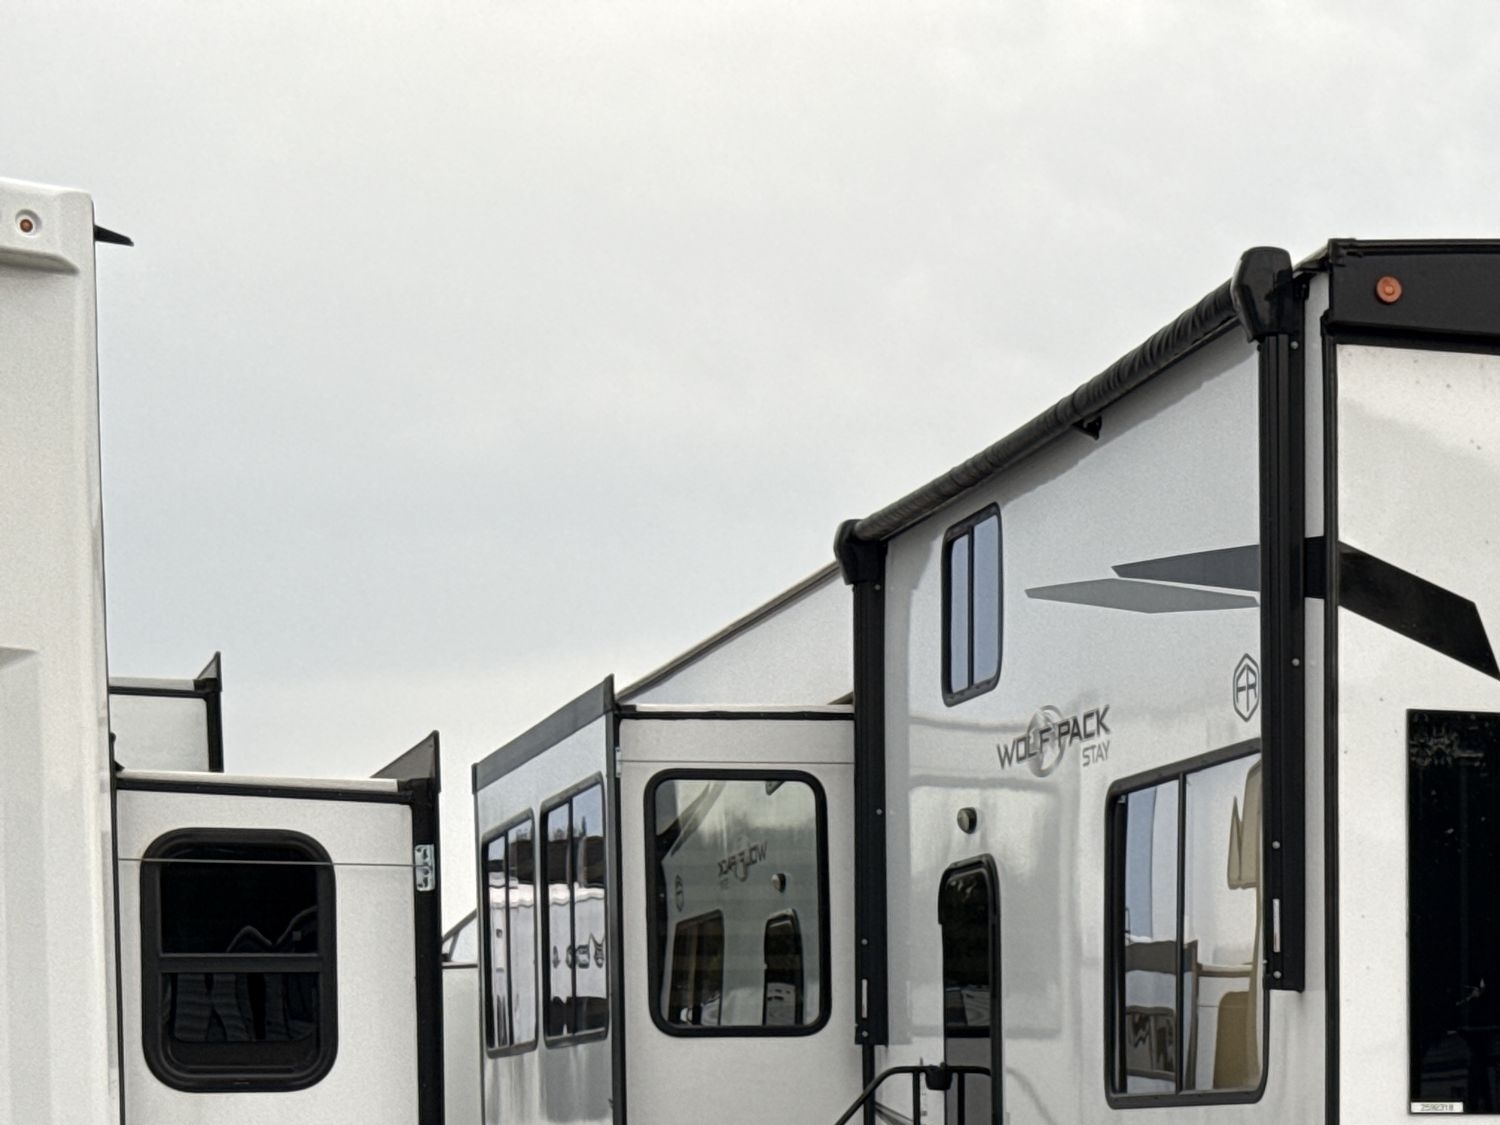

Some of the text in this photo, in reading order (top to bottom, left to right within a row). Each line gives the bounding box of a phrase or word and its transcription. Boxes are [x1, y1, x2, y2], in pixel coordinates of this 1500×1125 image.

[996, 704, 1111, 769] WOLF PACK
[1082, 740, 1110, 767] STAY
